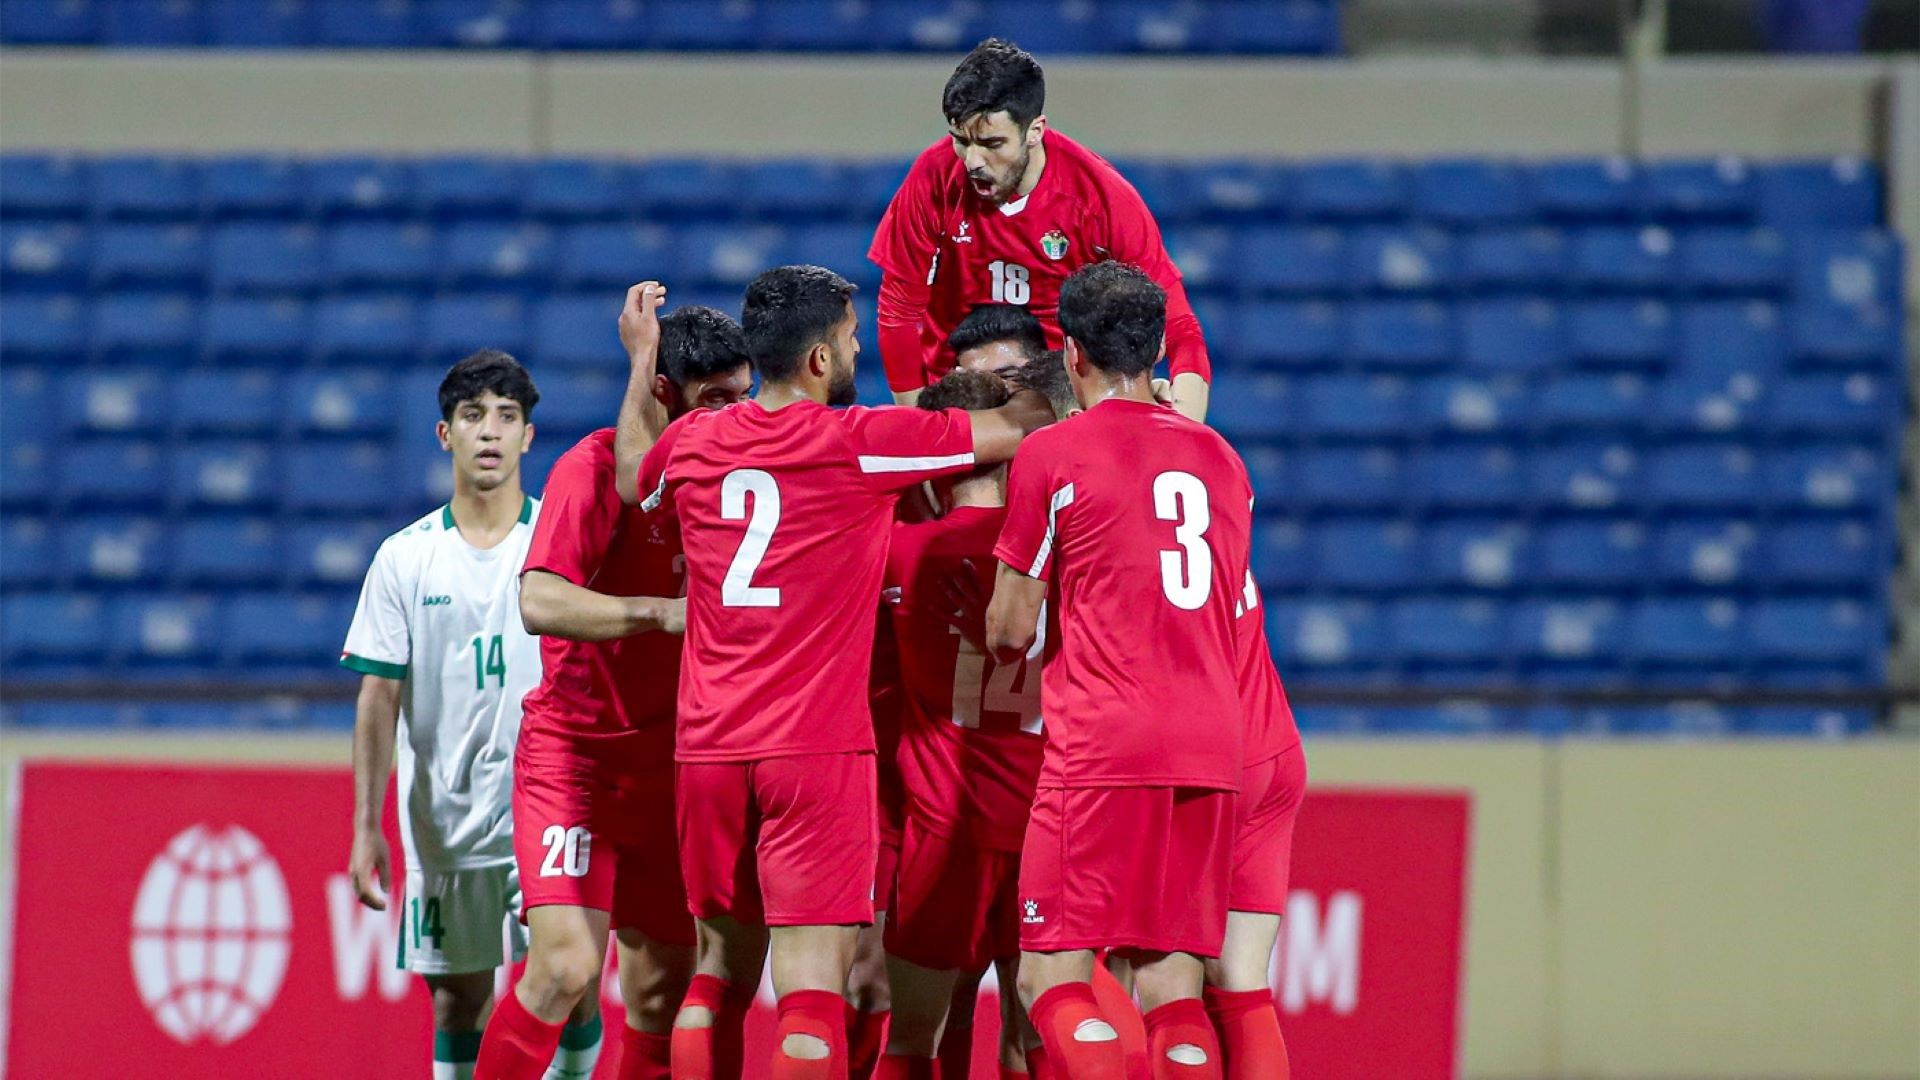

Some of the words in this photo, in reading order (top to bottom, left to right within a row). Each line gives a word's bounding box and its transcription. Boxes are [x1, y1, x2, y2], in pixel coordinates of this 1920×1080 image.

[988, 260, 1031, 305] 18
[721, 468, 781, 607] 2
[1152, 470, 1213, 610] 3
[422, 595, 452, 606] JAKO
[472, 634, 506, 690] 14
[947, 598, 1047, 736] 14
[540, 824, 592, 877] 20
[410, 896, 445, 950] 14
